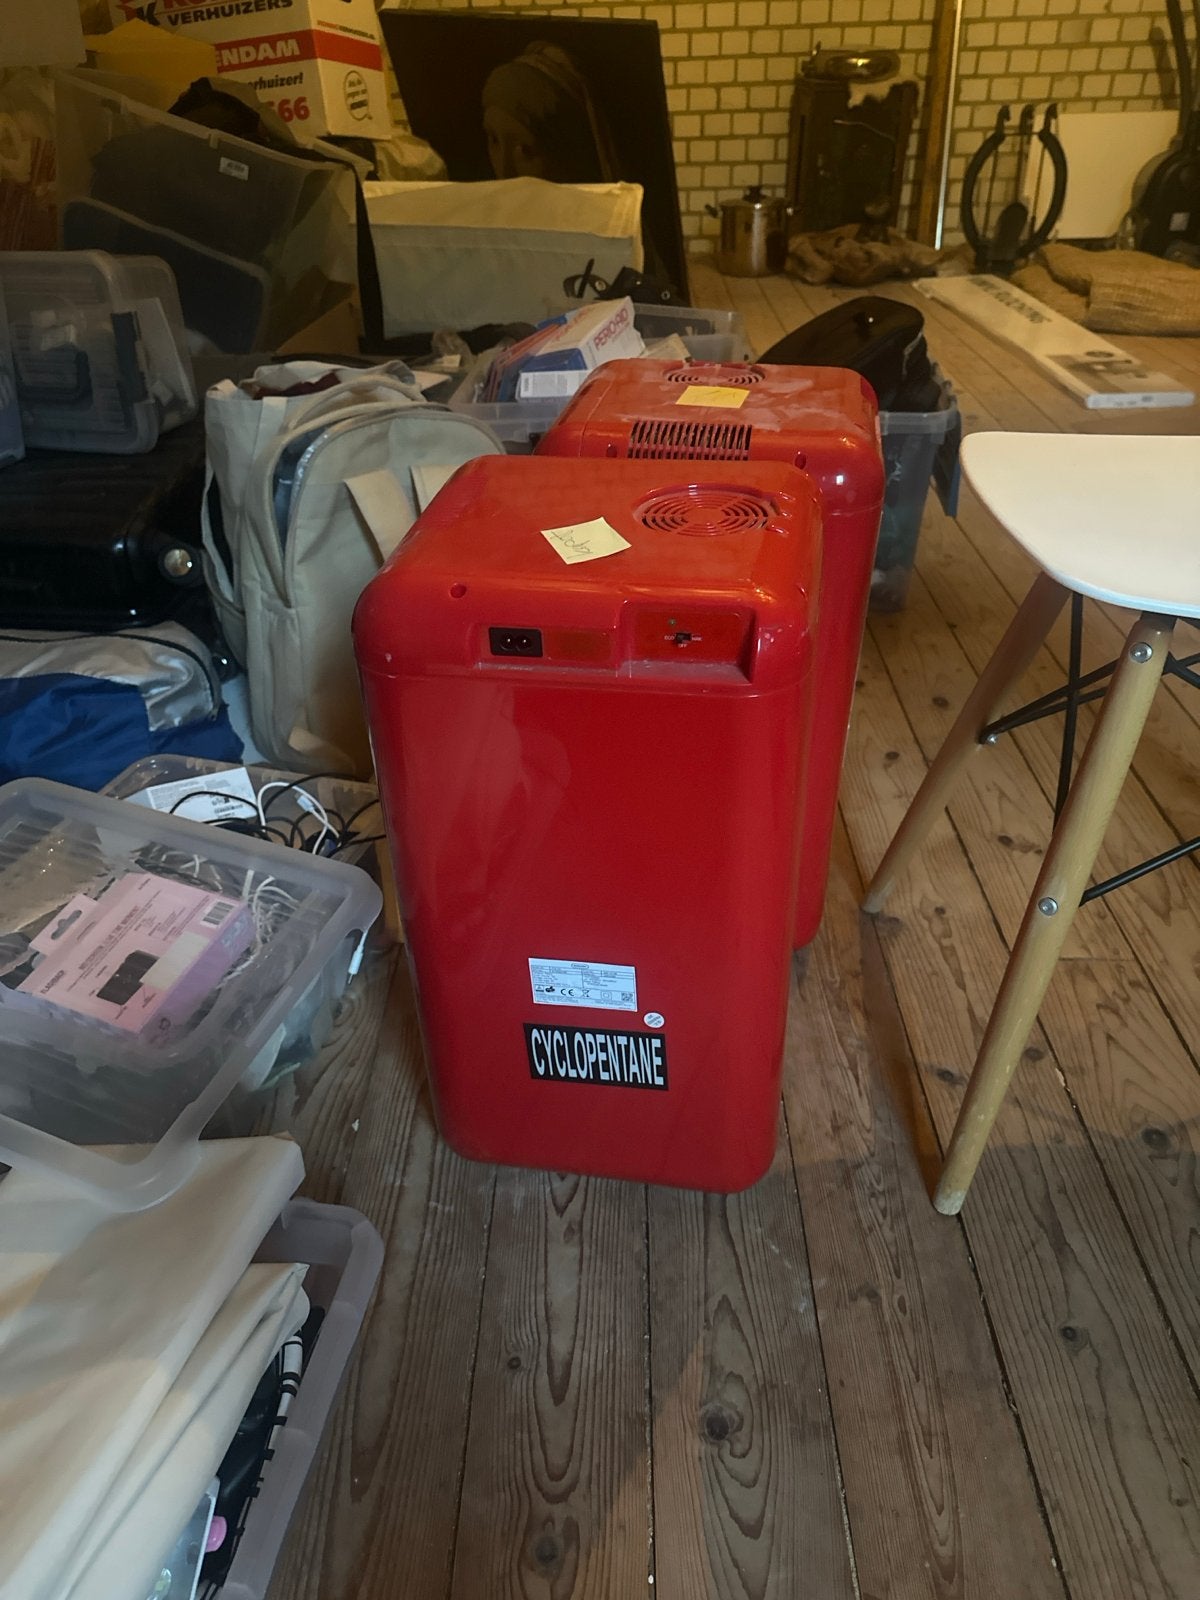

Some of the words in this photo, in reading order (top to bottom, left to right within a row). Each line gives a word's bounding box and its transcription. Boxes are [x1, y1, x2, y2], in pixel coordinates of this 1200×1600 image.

[167, 0, 293, 26] VERHUIZERS
[270, 96, 310, 122] 66
[531, 1028, 664, 1085] CYCLOPENTANE
